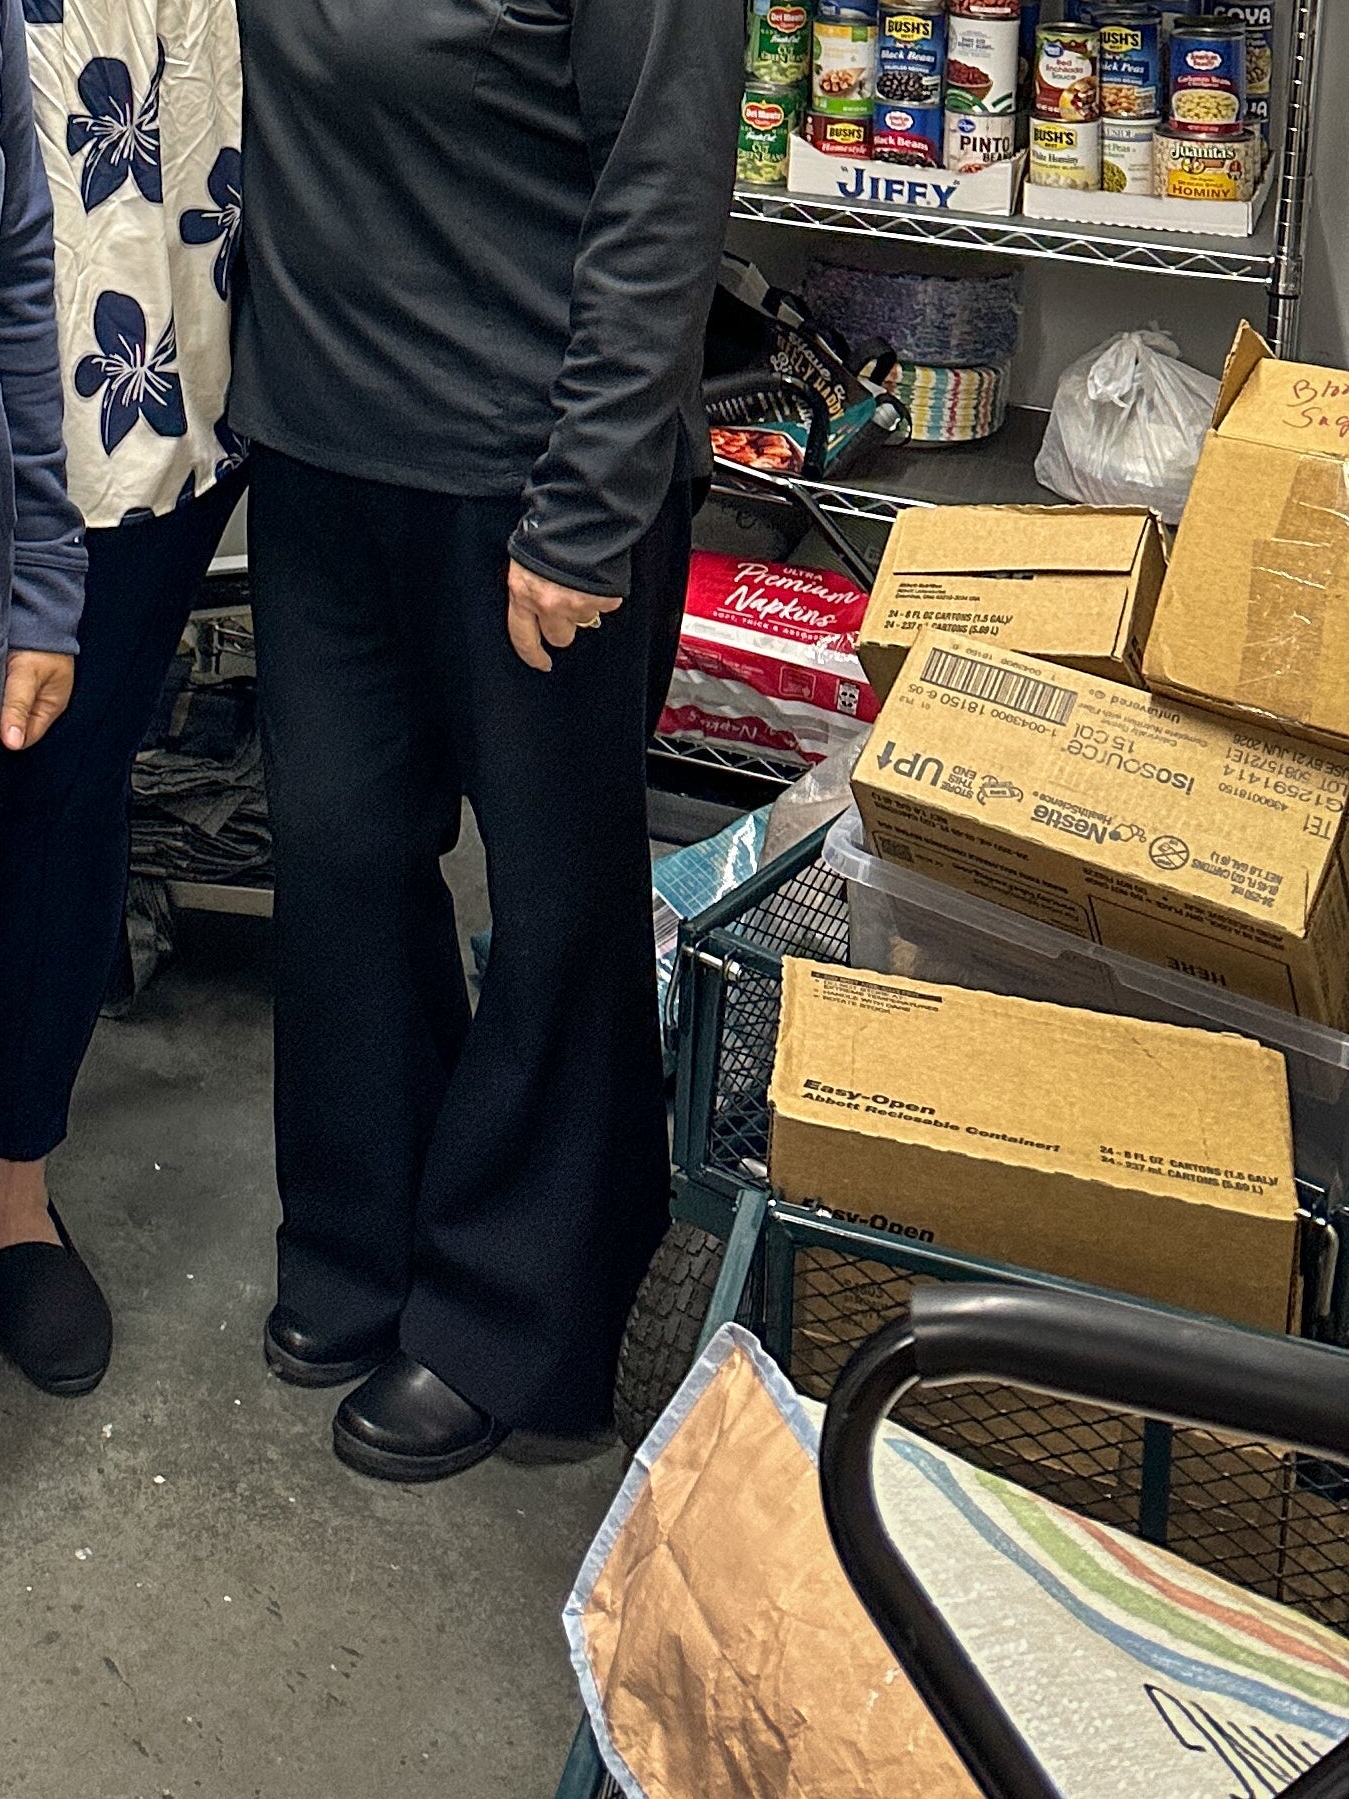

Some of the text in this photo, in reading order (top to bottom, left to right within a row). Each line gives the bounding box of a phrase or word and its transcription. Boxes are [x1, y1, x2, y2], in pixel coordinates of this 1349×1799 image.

[887, 19, 930, 37] BUSH'S
[1121, 64, 1145, 75] Peas
[829, 125, 862, 138] BUSH'S
[1034, 127, 1074, 145] BUSH'S
[898, 136, 928, 150] Beans
[960, 135, 1010, 151] PINTO
[1172, 184, 1230, 198] HOMINY
[733, 563, 860, 604] Premium
[783, 567, 823, 581] ULTRA
[724, 585, 837, 627] Napkins
[742, 617, 769, 630] THICK
[884, 620, 894, 629] 24
[901, 622, 916, 630] 237
[888, 609, 898, 618] 24
[912, 611, 921, 619] FL
[923, 611, 934, 620] OZ
[935, 611, 972, 623] CARTONS
[939, 694, 986, 717] 18150
[1110, 694, 1181, 724] Unflavored
[1233, 732, 1262, 752] 2026
[1262, 741, 1290, 760] JUN
[1066, 738, 1195, 797] isosource
[1292, 751, 1307, 765] 21
[1307, 758, 1323, 773] BY
[892, 753, 944, 787] UP
[952, 764, 977, 780] END
[940, 781, 974, 800] STORE
[948, 774, 973, 790] THIS
[1222, 764, 1344, 813] G12591414
[1320, 777, 1348, 798] LOT
[1302, 813, 1332, 840] TE1
[1191, 858, 1230, 879] CARTONS
[802, 1078, 936, 1115] Easy-Open
[801, 1091, 861, 1112] Abbott
[863, 1104, 961, 1132] Reclosable
[1100, 1145, 1114, 1154] 24
[1134, 1152, 1147, 1163] FL
[1149, 1155, 1164, 1165] OZ
[1169, 1158, 1222, 1177] CARTONS
[1224, 1168, 1246, 1180] (1.5
[1101, 1155, 1116, 1165] 24
[1124, 1161, 1145, 1172] 237
[1167, 1168, 1220, 1187] CARTONS
